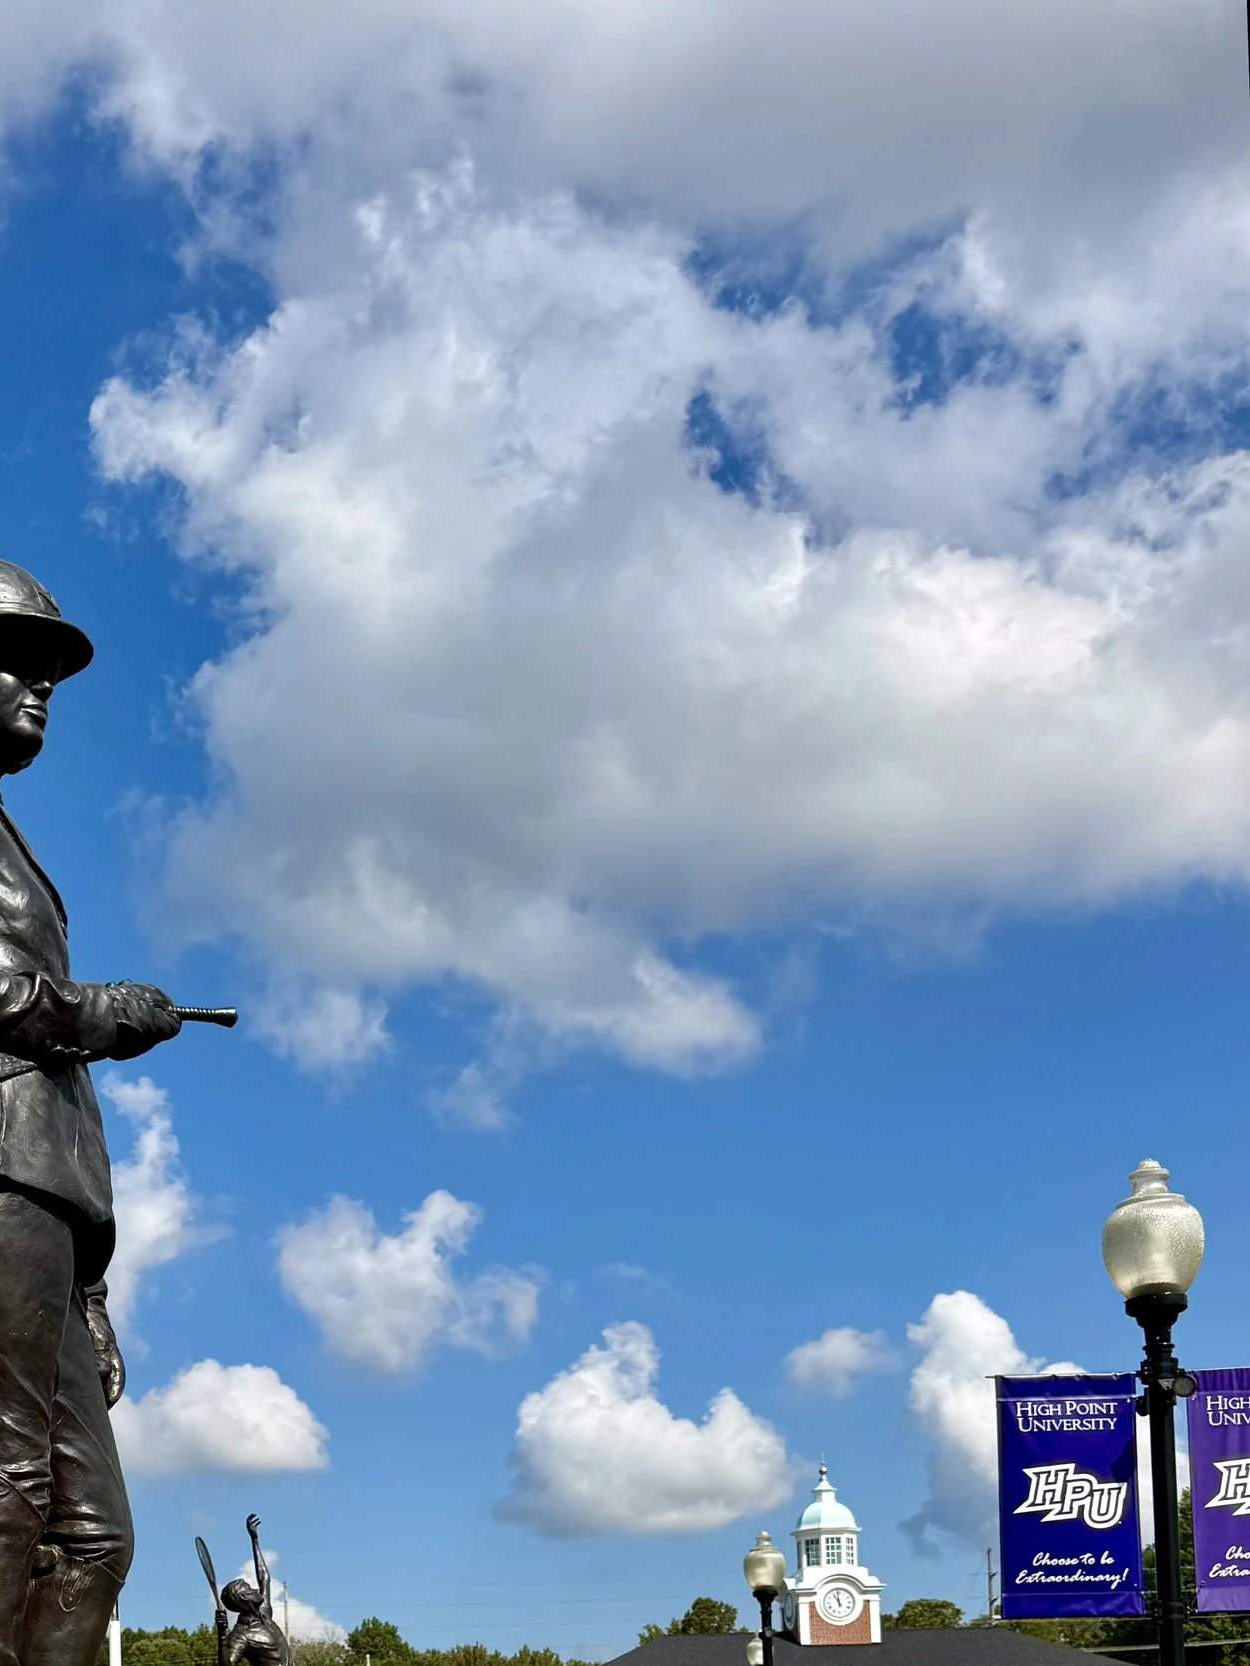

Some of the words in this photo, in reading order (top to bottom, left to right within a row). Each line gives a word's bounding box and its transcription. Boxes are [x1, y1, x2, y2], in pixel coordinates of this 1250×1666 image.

[1016, 1401, 1062, 1417] HIGH
[1065, 1400, 1118, 1415] POINT
[1017, 1417, 1118, 1432] UNIVERSITY
[1012, 1463, 1128, 1529] HPU
[1032, 1551, 1080, 1566] Choose
[1079, 1552, 1096, 1565] to
[1100, 1550, 1115, 1565] be
[1015, 1567, 1130, 1590] Extraordinary!
